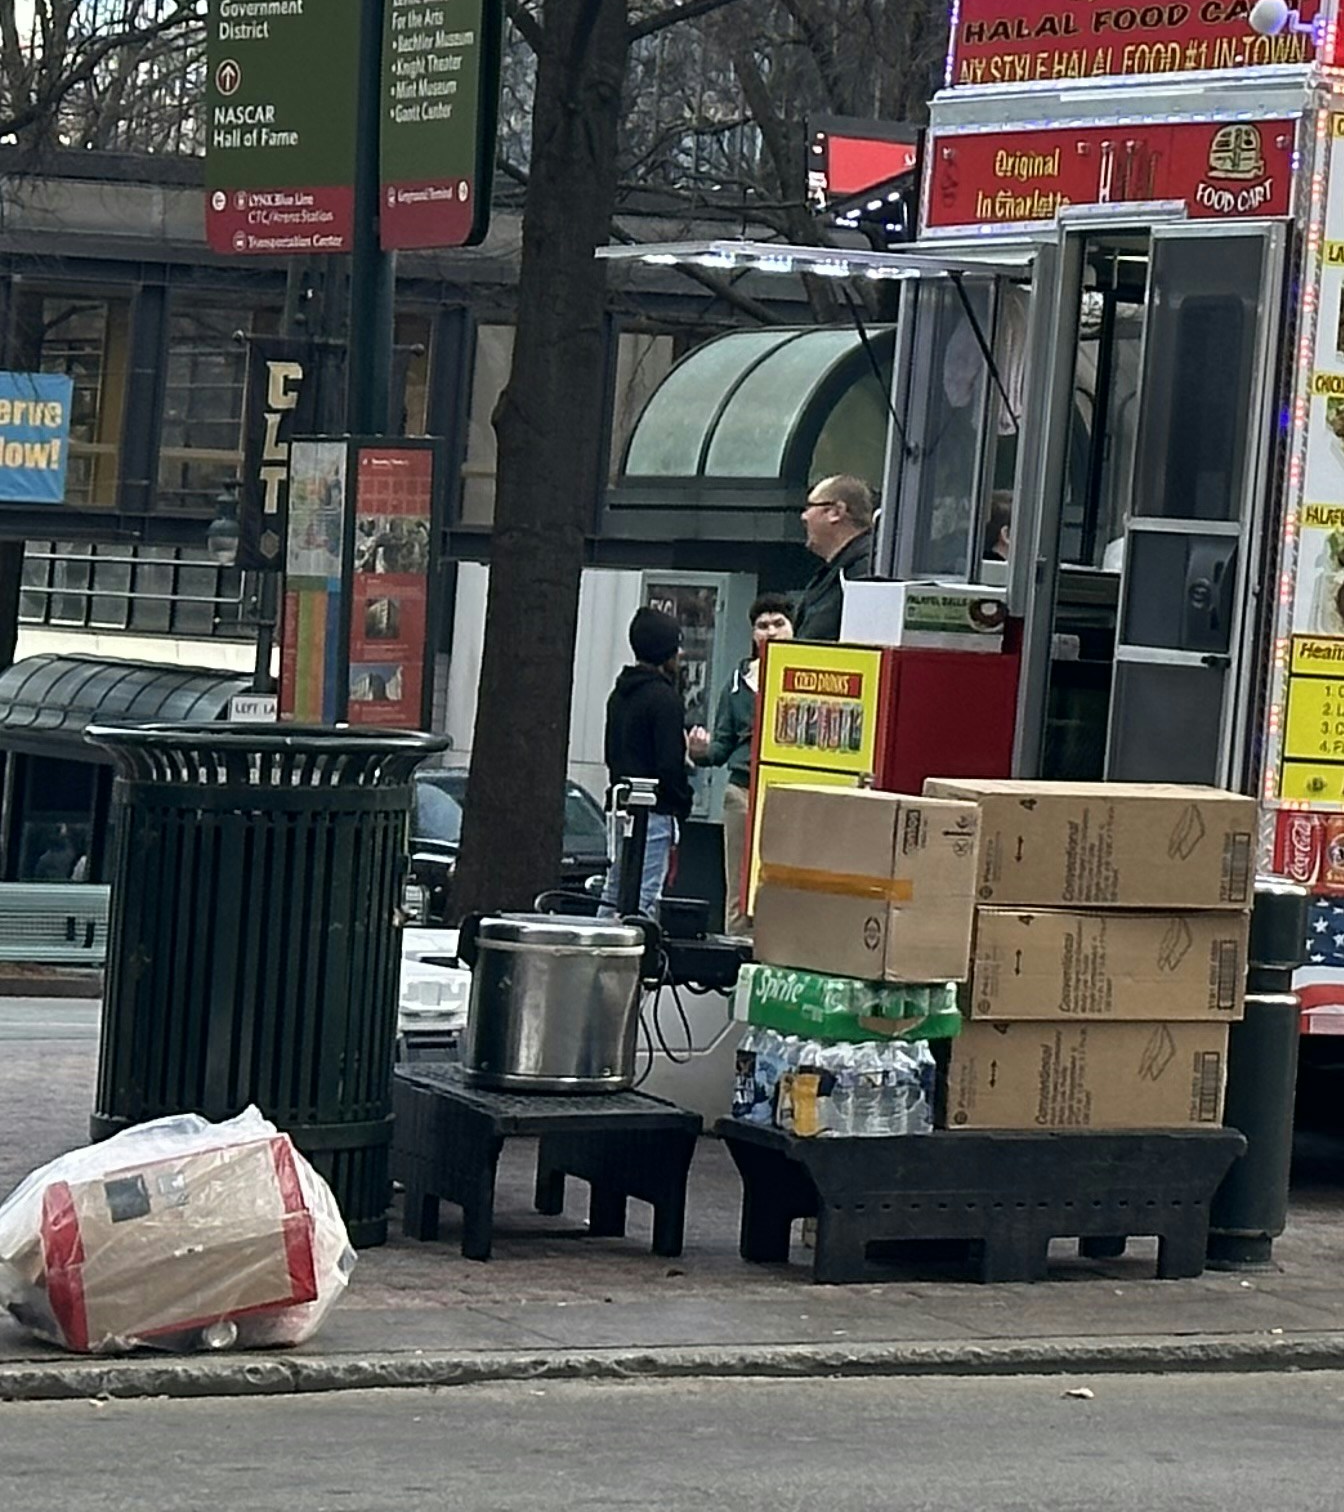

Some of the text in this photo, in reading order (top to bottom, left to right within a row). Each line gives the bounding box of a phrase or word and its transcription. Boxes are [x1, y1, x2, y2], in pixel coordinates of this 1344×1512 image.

[219, 21, 269, 39] District
[963, 12, 1080, 44] HALAL
[1092, 1, 1190, 34] FOOD
[990, 52, 1047, 83] STYLE
[1052, 46, 1114, 79] HALAL
[1122, 41, 1181, 75] FOOD
[214, 105, 275, 125] NASCAR
[213, 128, 299, 148] Hall of Fame
[995, 146, 1061, 182] Original
[976, 190, 992, 219] In
[1195, 178, 1274, 213] FOOD CART
[0, 436, 61, 470] ow!
[756, 968, 806, 1005] Sprite
